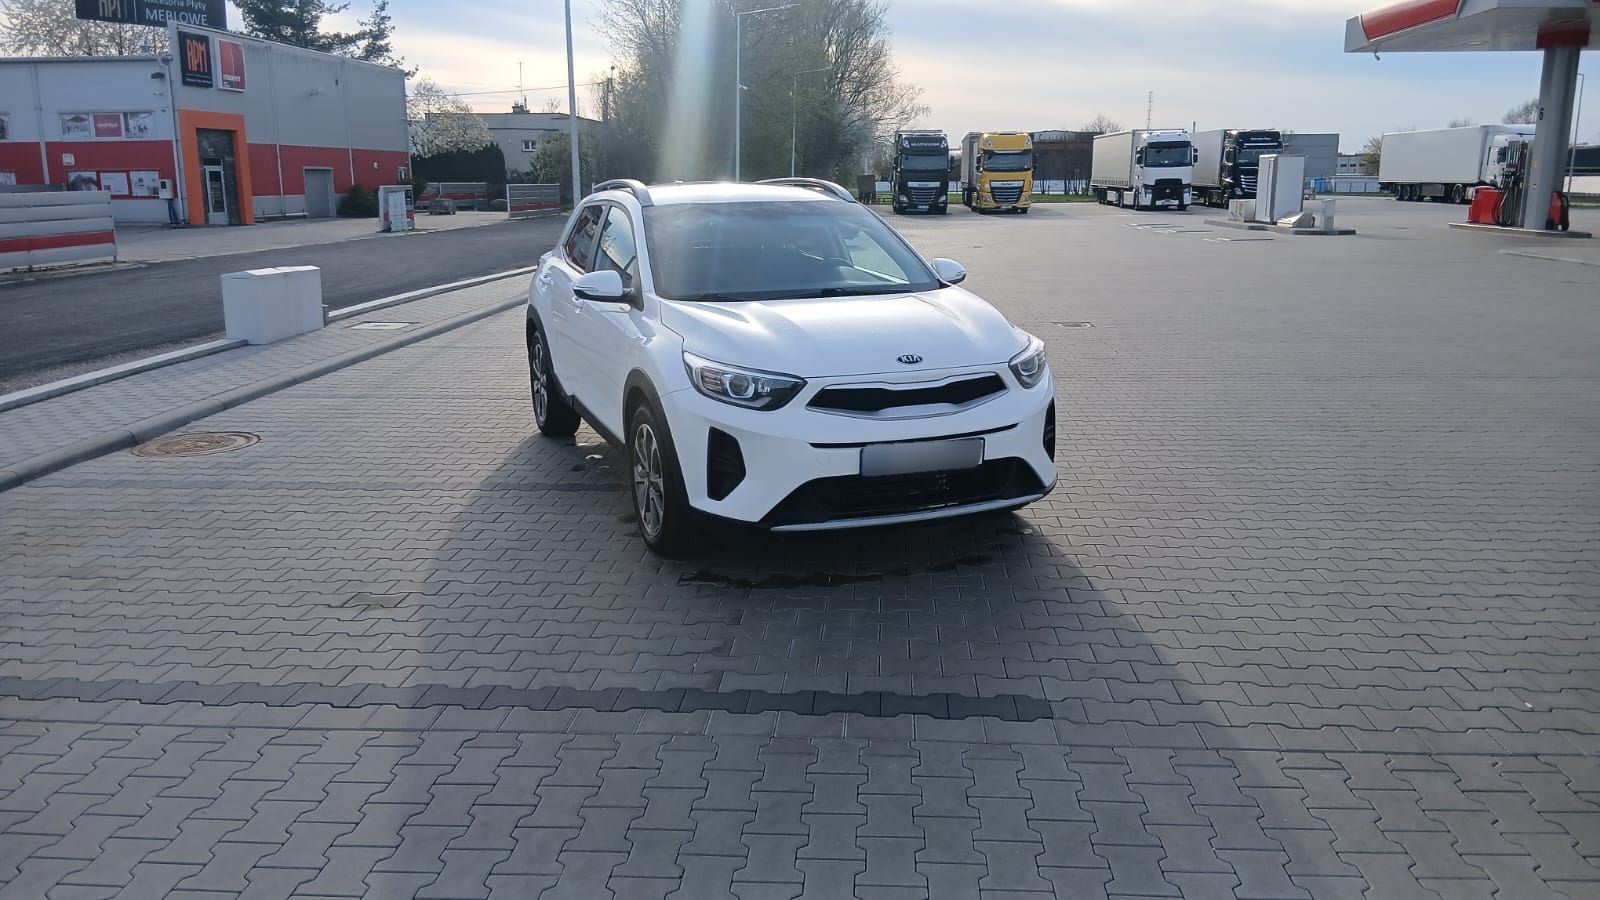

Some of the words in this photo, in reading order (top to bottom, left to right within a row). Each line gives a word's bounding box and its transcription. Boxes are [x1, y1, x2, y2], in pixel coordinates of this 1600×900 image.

[145, 7, 208, 26] MEBLOWE
[186, 38, 208, 73] RPM
[1539, 107, 1544, 120] 6
[900, 355, 921, 363] KIA
